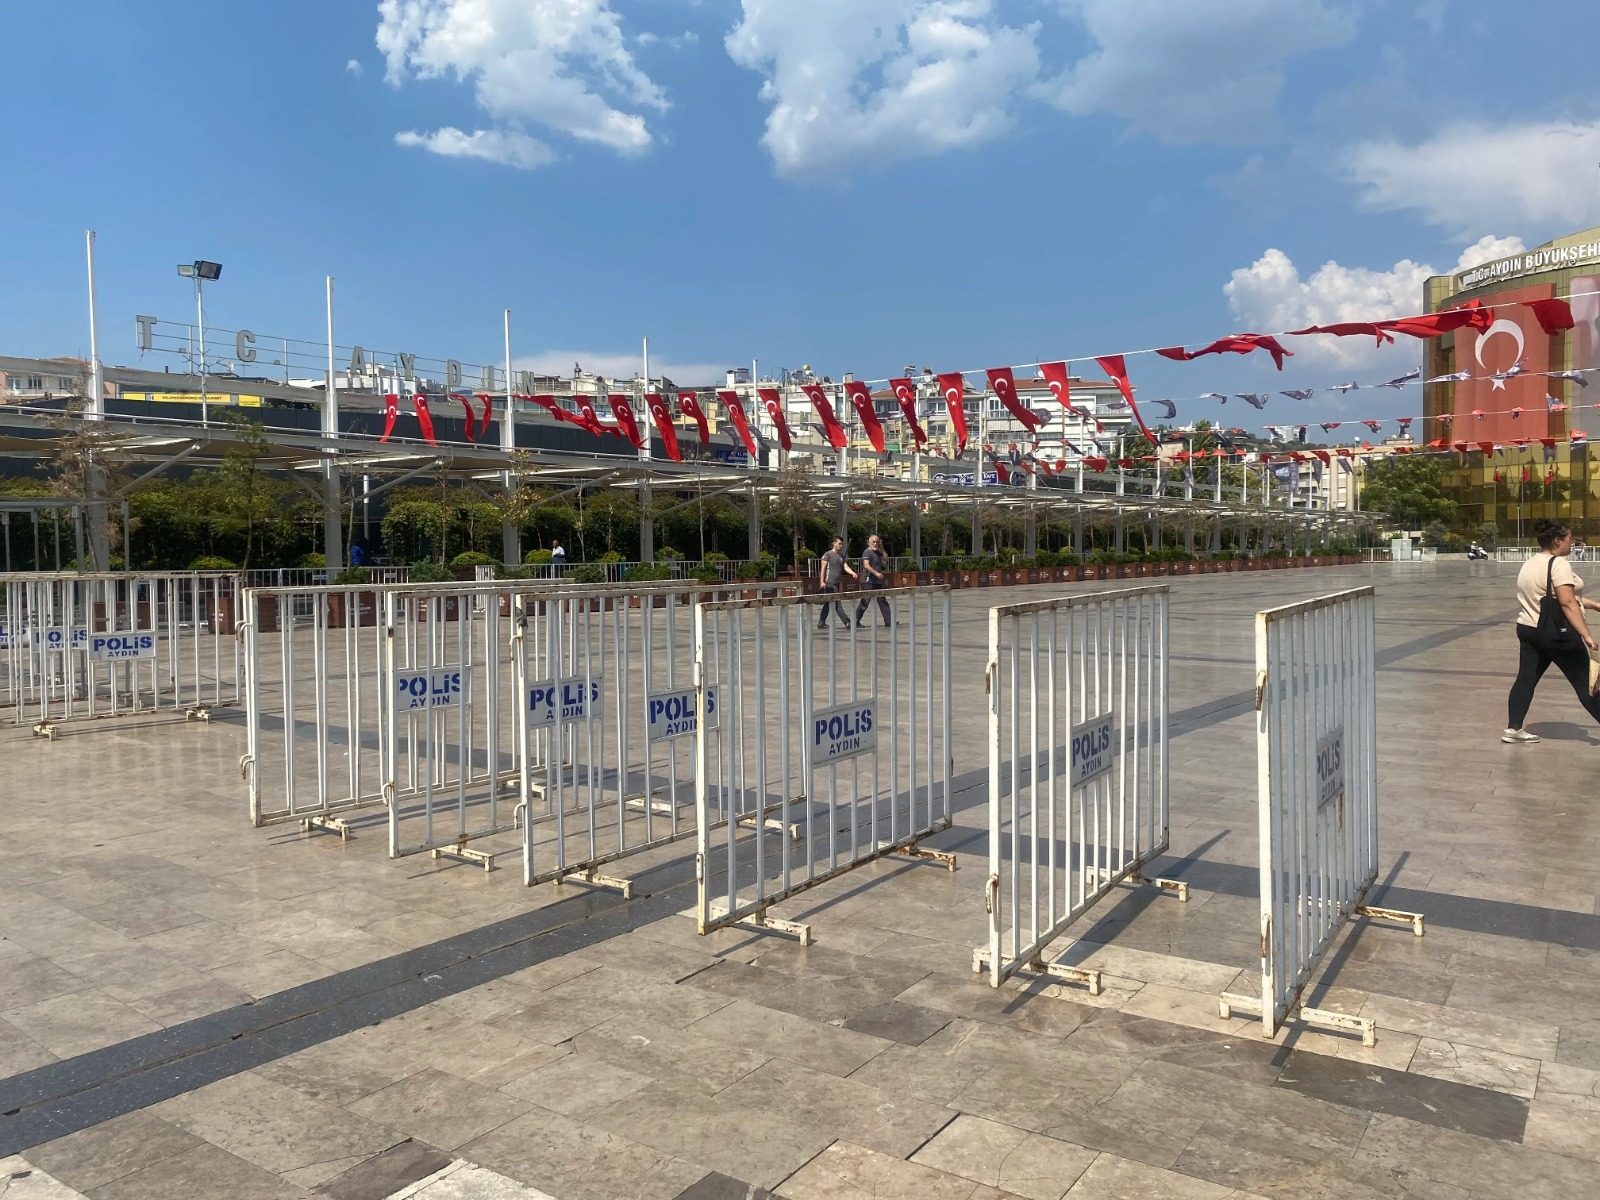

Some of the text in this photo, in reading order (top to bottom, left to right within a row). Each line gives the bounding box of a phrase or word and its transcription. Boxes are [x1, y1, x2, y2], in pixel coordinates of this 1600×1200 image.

[1490, 257, 1521, 277] AYDIN
[829, 737, 860, 756] AYDIN
[1081, 755, 1101, 778] AYDIN
